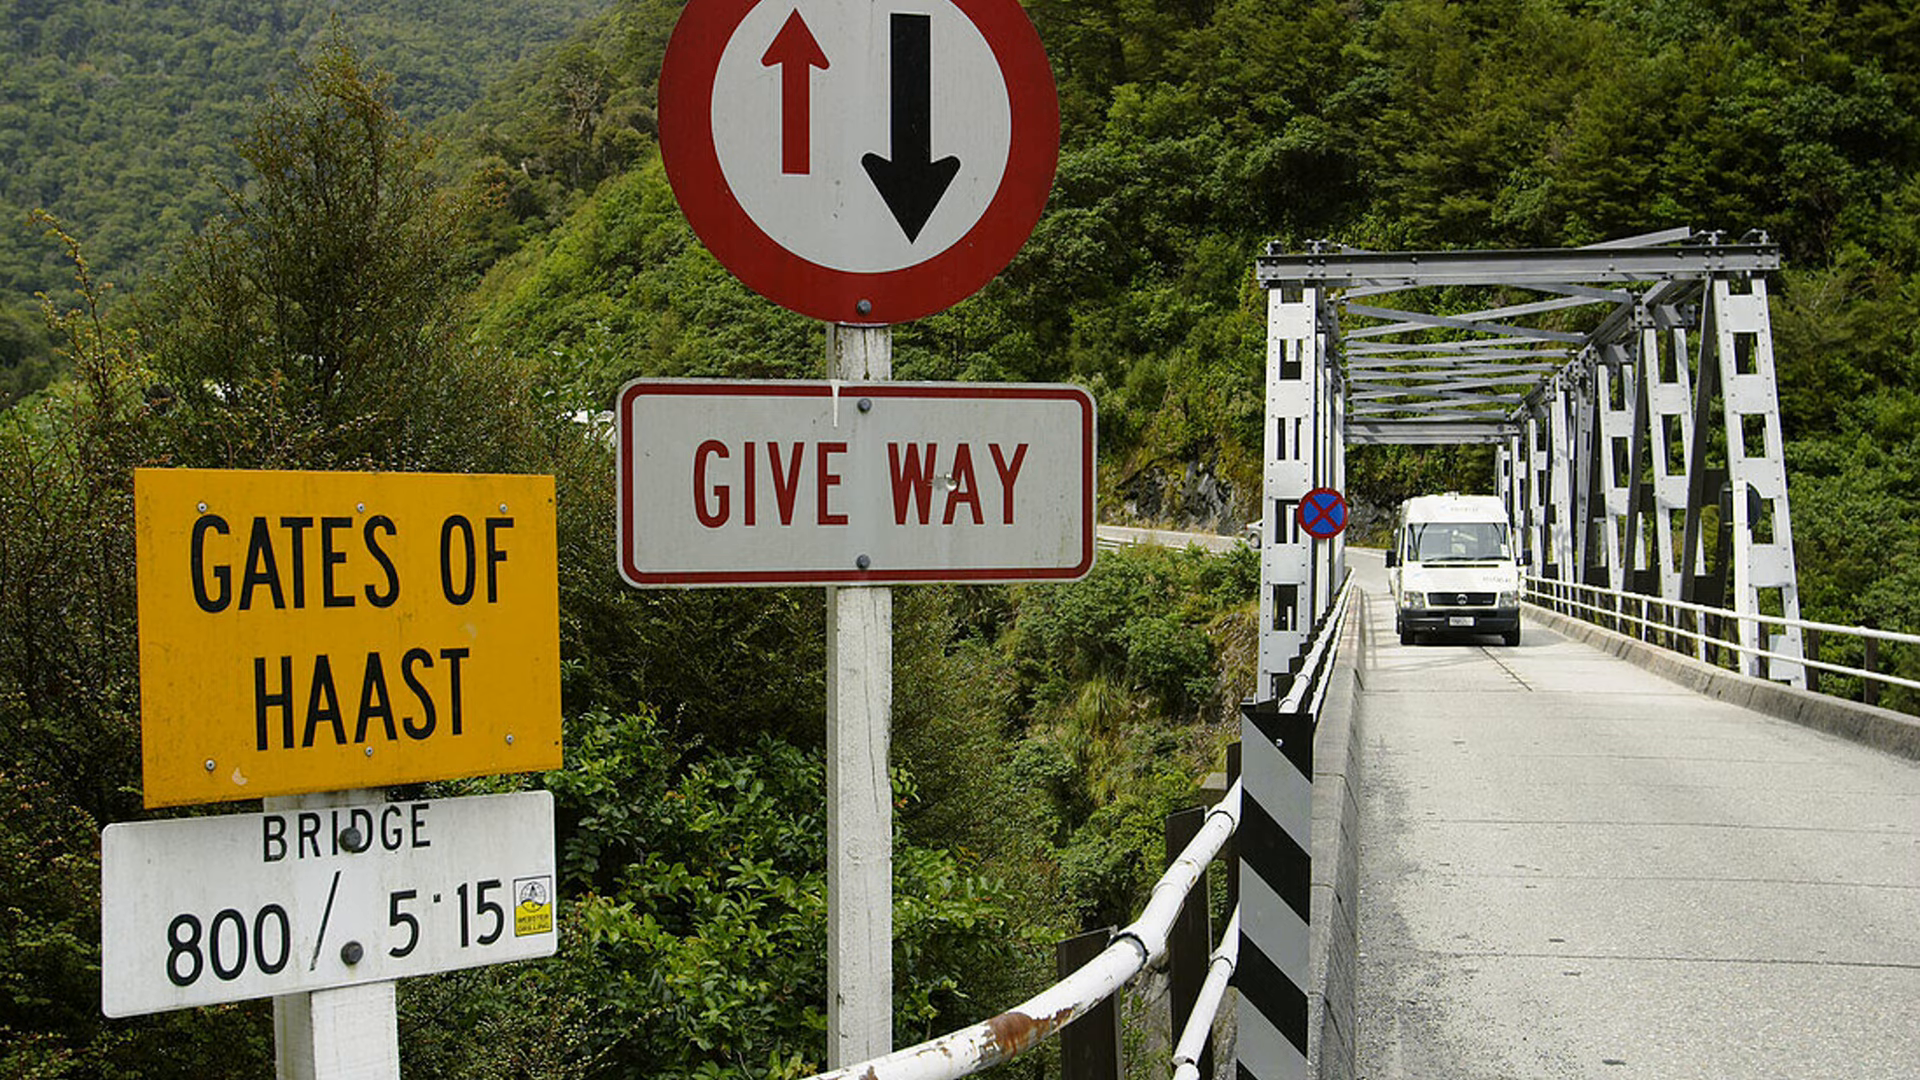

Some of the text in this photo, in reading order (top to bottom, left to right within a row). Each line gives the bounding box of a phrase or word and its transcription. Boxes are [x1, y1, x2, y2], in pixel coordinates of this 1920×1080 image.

[693, 439, 1029, 529] GIVE WAY
[190, 513, 515, 613] GATES OF
[253, 647, 470, 751] HAAST
[262, 803, 431, 863] BRIDGE
